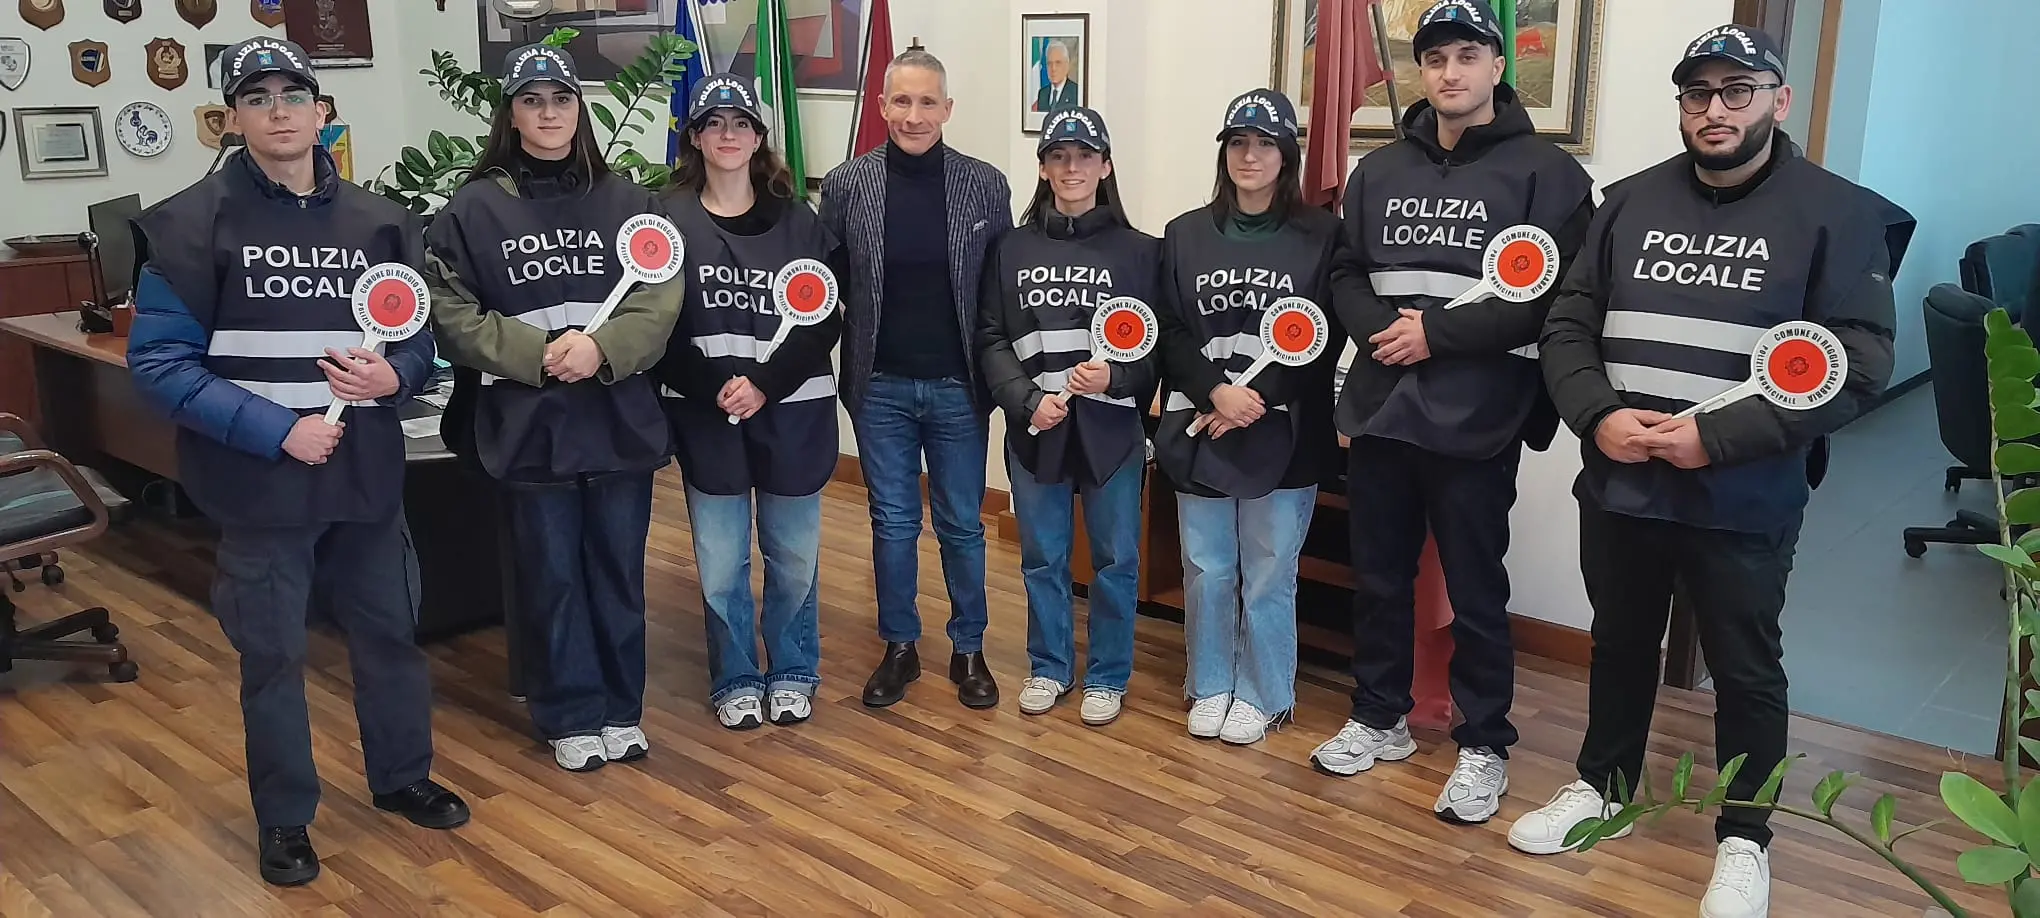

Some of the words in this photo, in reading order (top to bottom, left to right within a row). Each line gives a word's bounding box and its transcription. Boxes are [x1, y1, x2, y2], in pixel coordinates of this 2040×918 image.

[1422, 0, 1449, 26] OLIZIA
[1688, 29, 1719, 57] OLIZIA
[1720, 27, 1757, 55] LOCALE
[233, 41, 262, 77] POLIZIA
[263, 40, 304, 70] LOCALE
[512, 48, 539, 79] POLIZIA
[540, 47, 571, 78] LOCALE
[698, 78, 724, 107] POLIZIA
[725, 78, 753, 107] LOCALE
[1253, 94, 1280, 123] LOCALE
[1044, 109, 1070, 140] POLIZIA
[1070, 109, 1098, 137] LOCALE
[1384, 197, 1488, 222] POLIZIA
[501, 228, 604, 260] POLIZIA
[1382, 224, 1485, 250] LOCALE
[1501, 231, 1531, 245] COMUNE
[1531, 233, 1540, 242] DI
[1539, 238, 1555, 263] REGGIO
[1642, 230, 1770, 261] POLIZIA
[242, 245, 370, 270] POLIZIA
[245, 275, 358, 298] LOCAL
[360, 271, 384, 294] COMUNE
[386, 269, 394, 277] DI
[395, 269, 419, 288] REGGIO
[699, 264, 775, 290] POLIZI
[1017, 265, 1113, 288] POLIZIA
[1195, 267, 1294, 293] POLIZIA
[1530, 264, 1554, 295] CALABRIA
[1633, 258, 1766, 291] LOCALE
[1197, 289, 1278, 316] LOCAL
[1774, 328, 1811, 341] COMUNE
[1811, 332, 1822, 342] DI
[1756, 344, 1769, 373] POLIZIA
[1820, 339, 1839, 369] REGGIO
[1758, 375, 1796, 405] MUNICIPALE
[1807, 370, 1839, 403] CALABRIA
